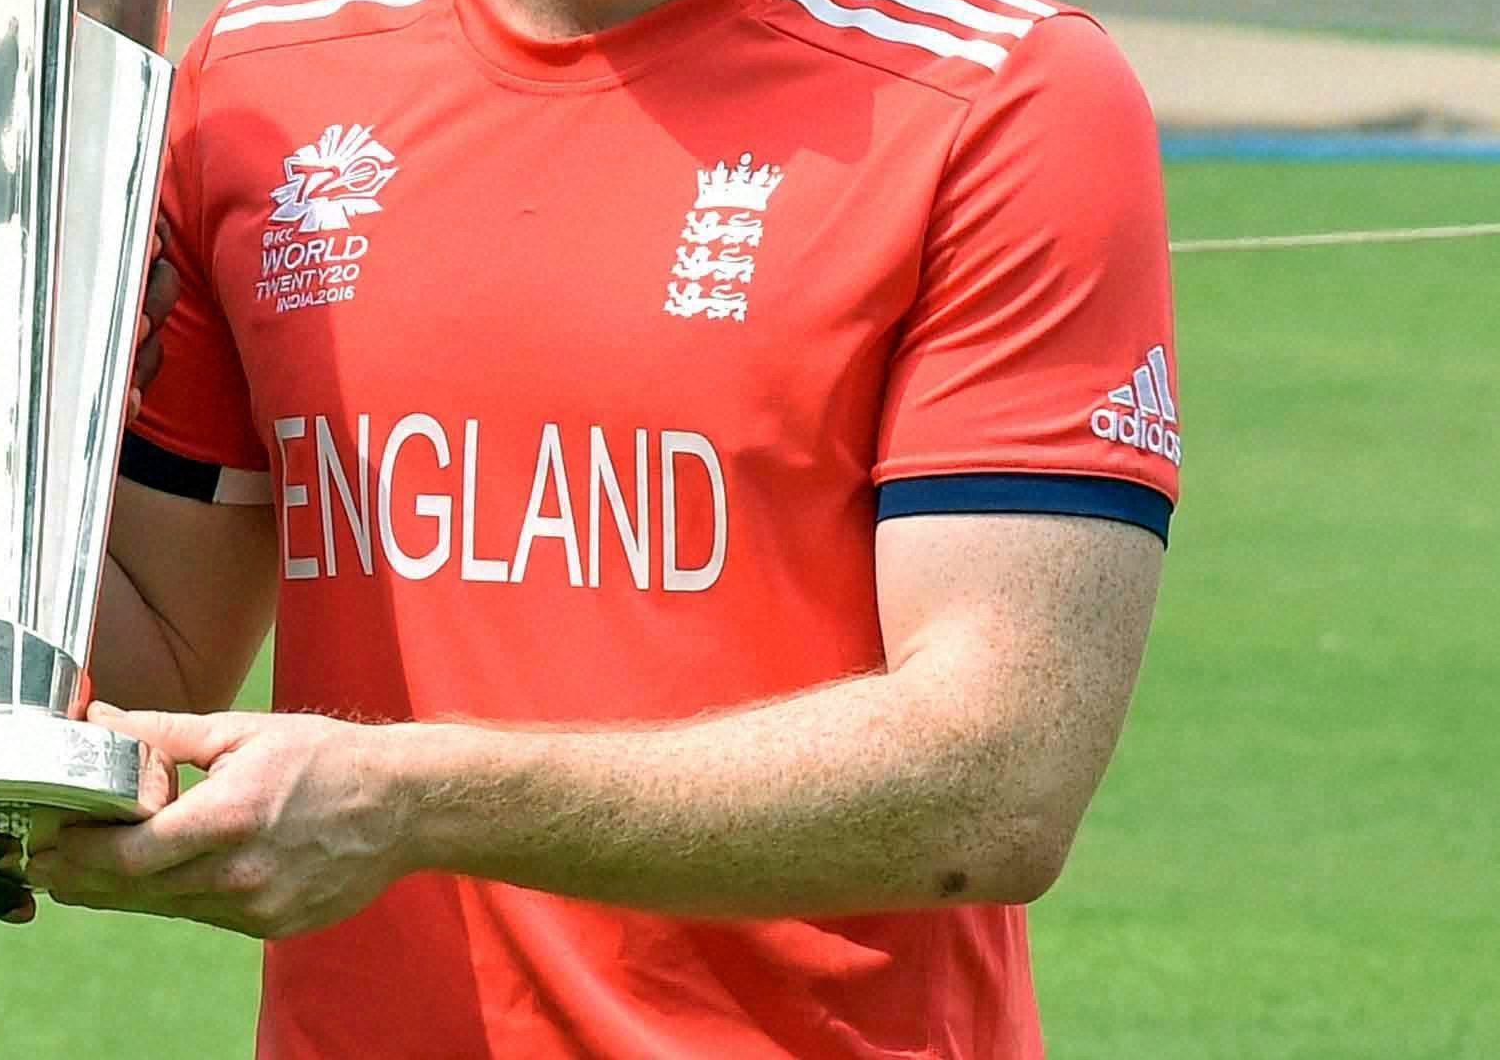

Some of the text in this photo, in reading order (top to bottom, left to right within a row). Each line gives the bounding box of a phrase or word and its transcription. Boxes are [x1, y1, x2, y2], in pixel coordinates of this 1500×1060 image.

[261, 235, 369, 278] WORLD
[254, 263, 360, 301] TWENTY20
[275, 285, 355, 314] INDIA 2016
[1090, 407, 1182, 466] adidas
[273, 412, 729, 593] ENGLAND
